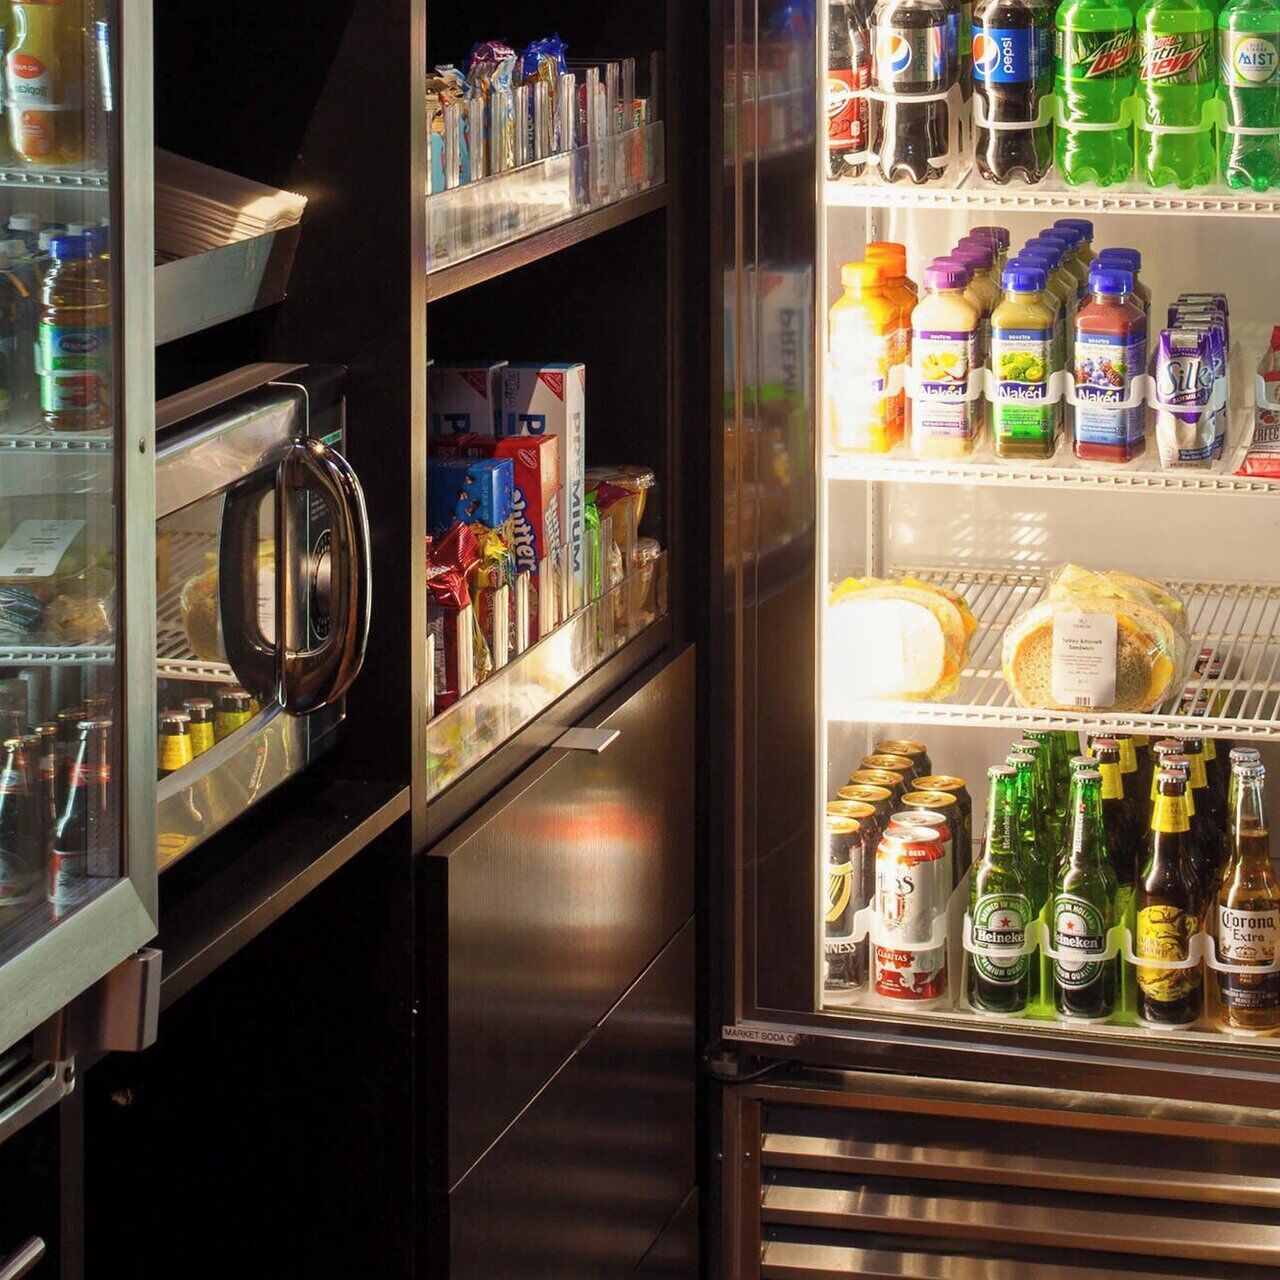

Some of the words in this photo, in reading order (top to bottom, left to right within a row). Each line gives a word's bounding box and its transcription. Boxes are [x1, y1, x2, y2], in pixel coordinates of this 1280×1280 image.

[1002, 36, 1016, 74] pepsi
[1237, 52, 1276, 65] MIST
[1160, 361, 1210, 396] Silk
[999, 386, 1042, 400] Naked
[1078, 388, 1120, 403] Naked
[571, 411, 583, 575] PREMIUM
[1221, 909, 1276, 932] Corona
[977, 928, 1025, 943] Heineke
[1054, 931, 1099, 948] eineken
[1232, 931, 1265, 943] Extra
[824, 942, 857, 955] NNESS
